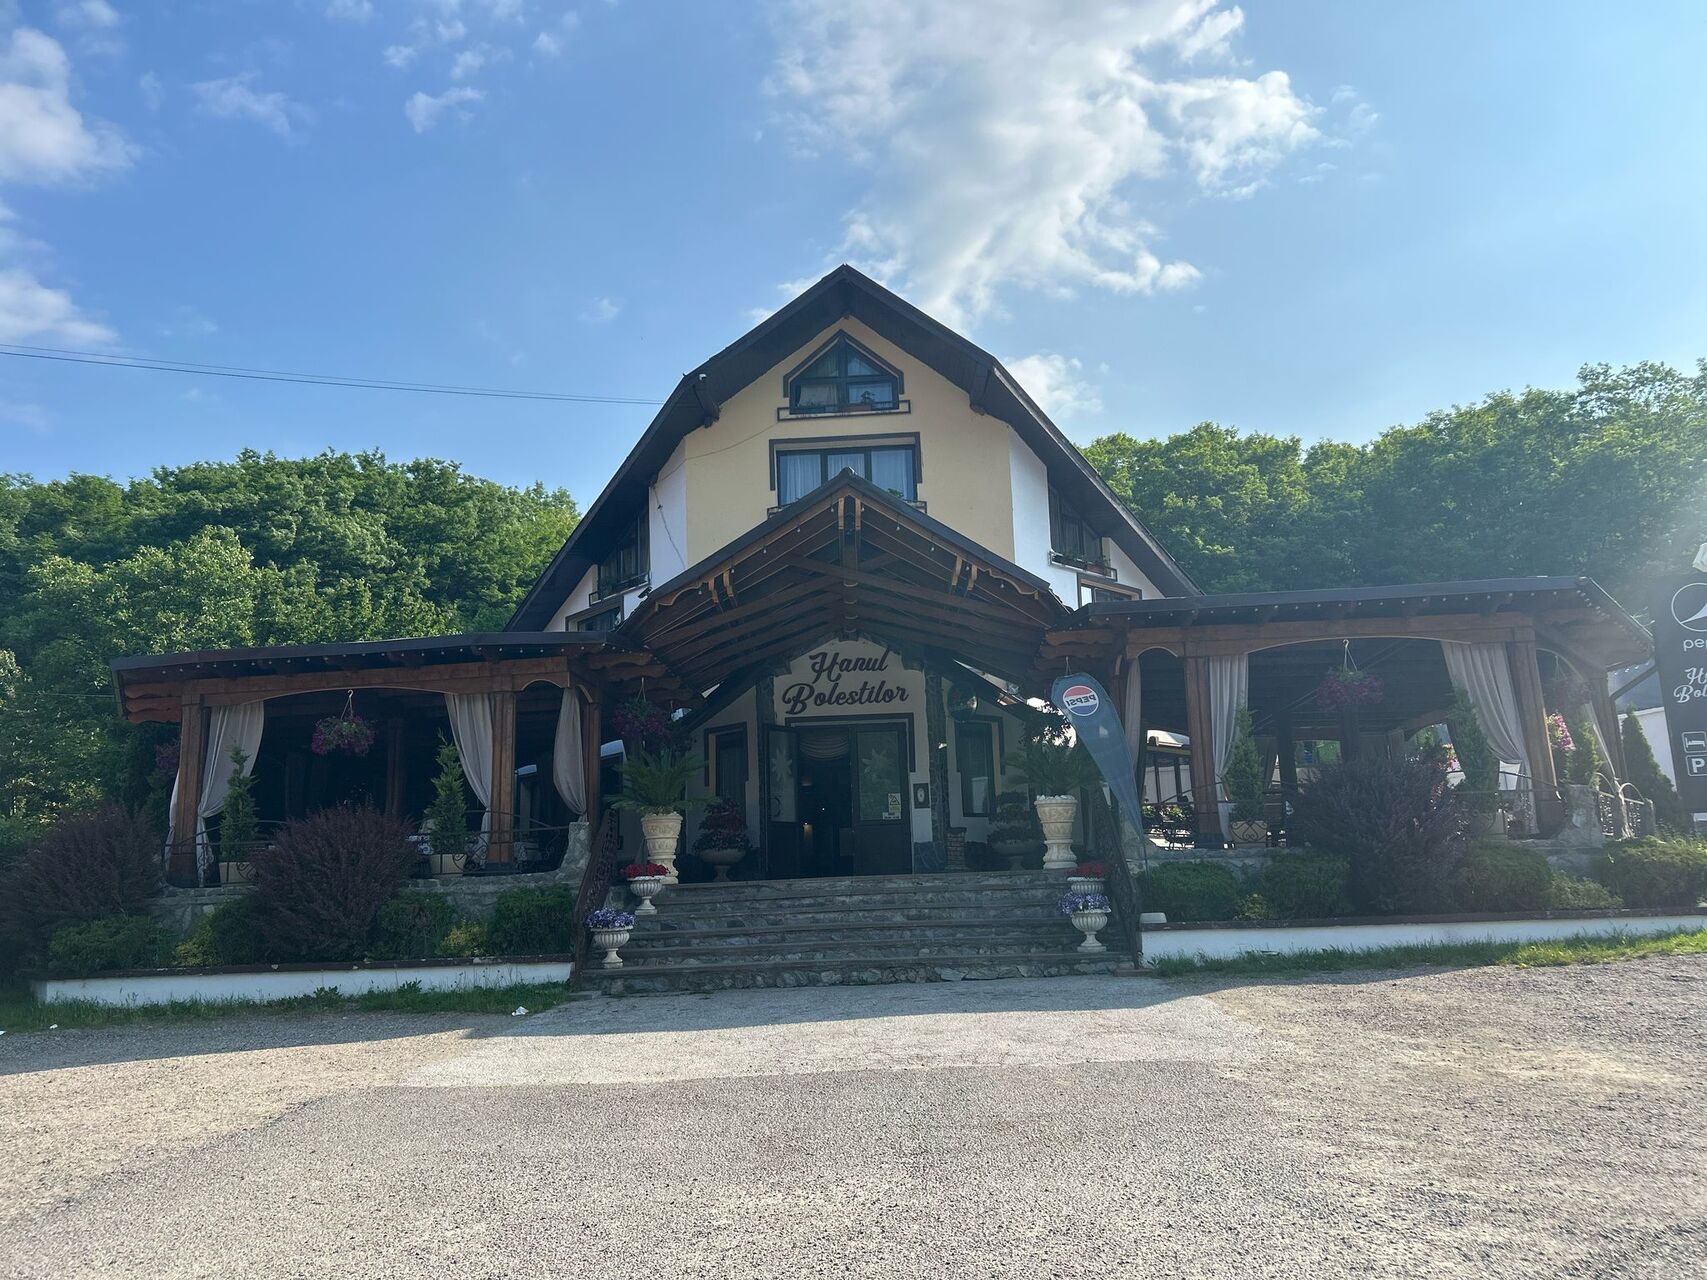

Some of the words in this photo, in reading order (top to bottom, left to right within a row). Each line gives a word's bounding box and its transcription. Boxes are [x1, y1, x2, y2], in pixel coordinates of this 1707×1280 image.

[1683, 638, 1707, 652] pe
[808, 648, 889, 684] Hanul
[782, 681, 909, 715] Bolestilor
